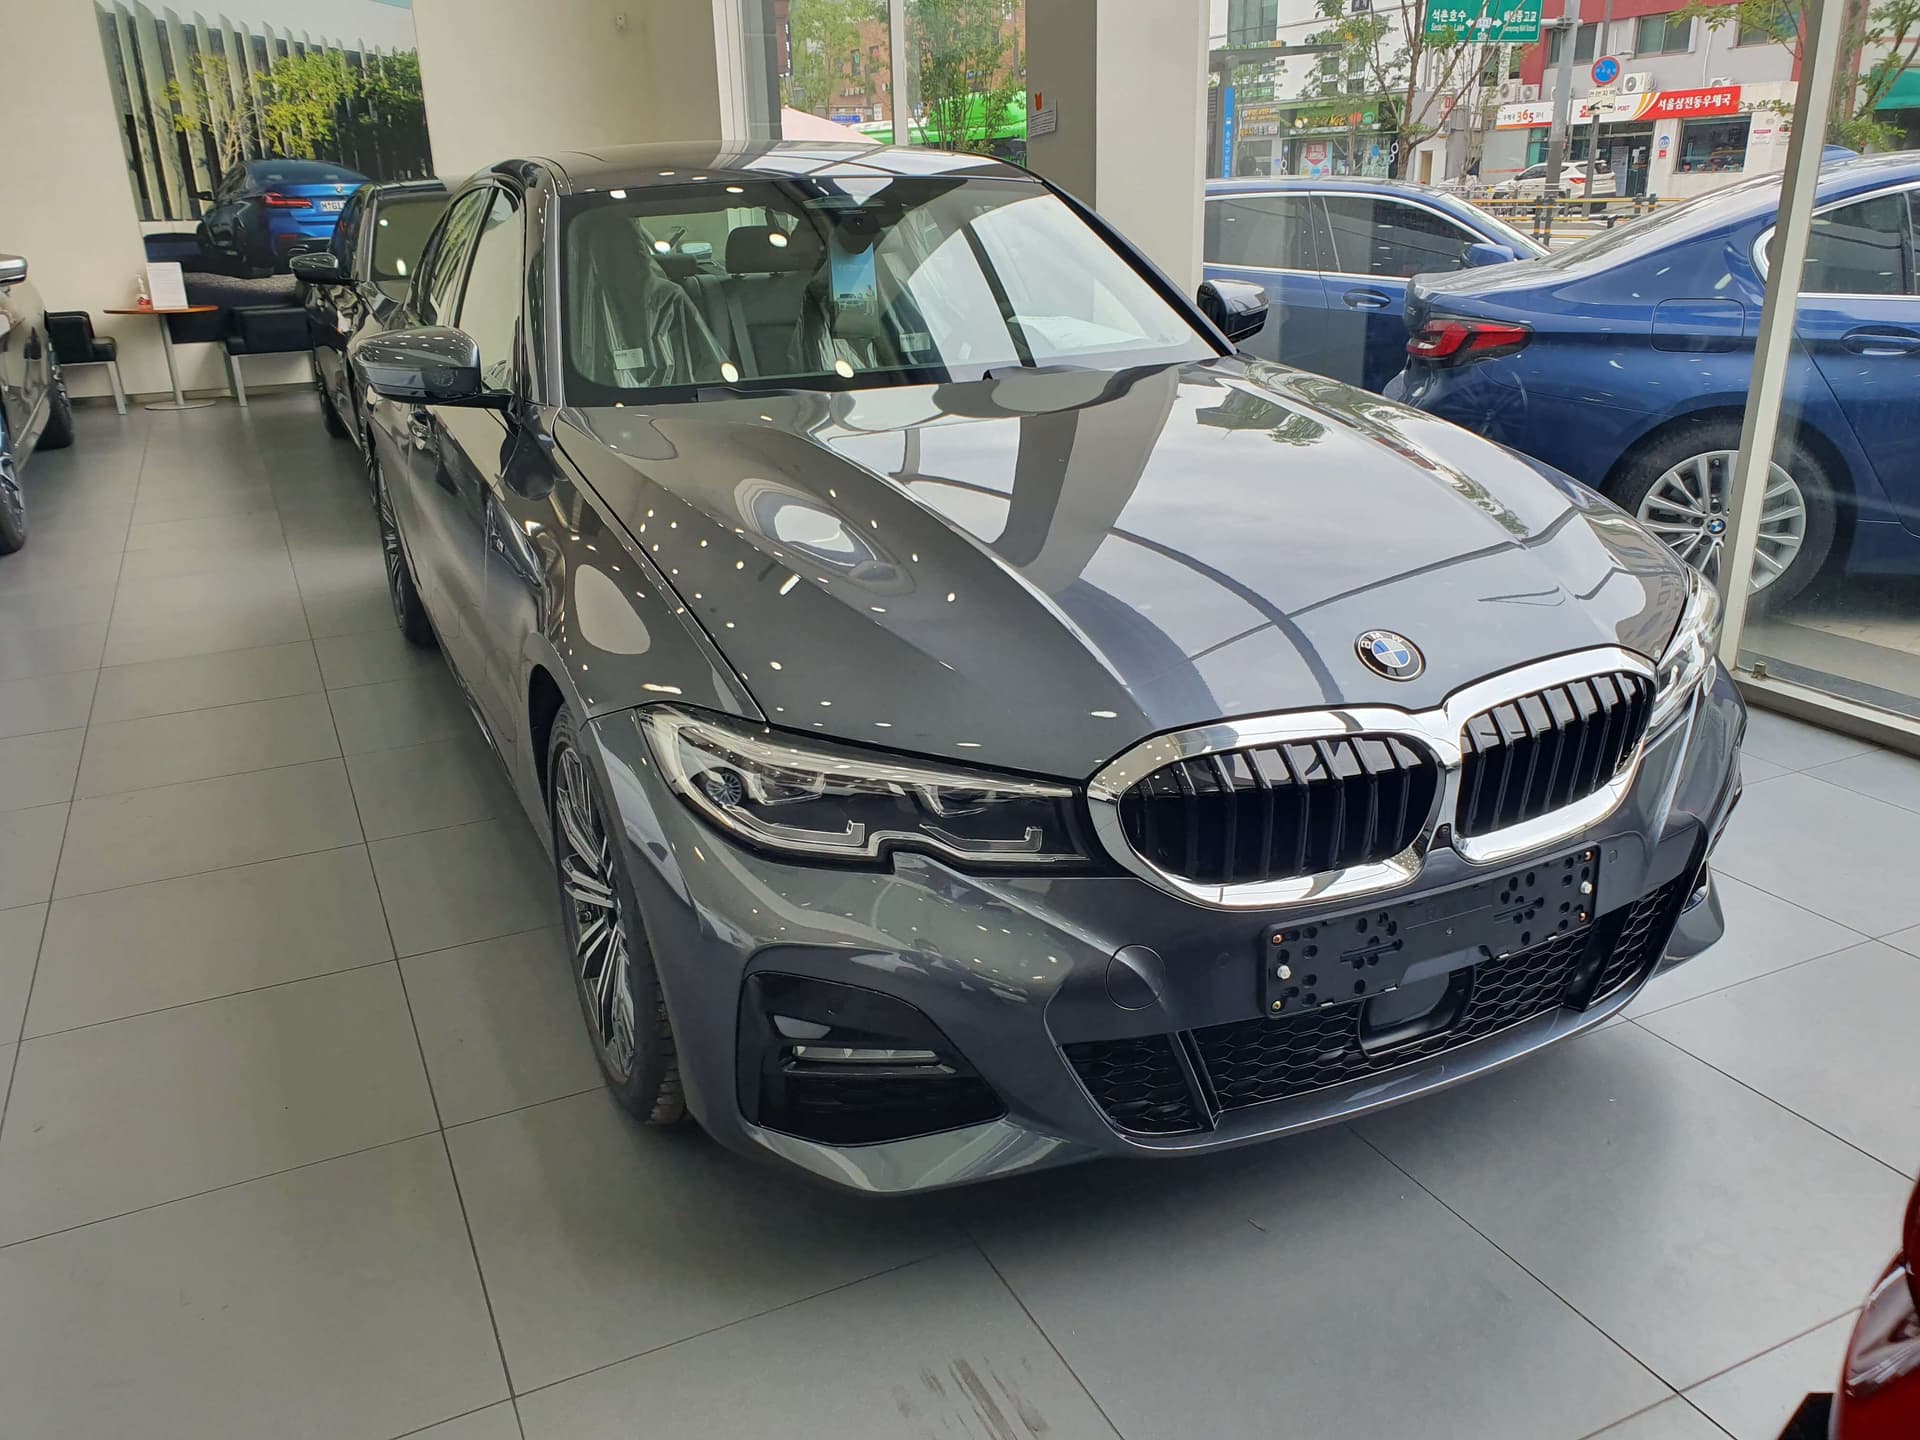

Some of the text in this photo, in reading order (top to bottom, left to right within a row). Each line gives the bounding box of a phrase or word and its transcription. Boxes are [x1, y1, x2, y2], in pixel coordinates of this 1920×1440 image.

[1658, 93, 1731, 111] 서울삼전동우체국
[1516, 109, 1534, 123] 365
[1360, 632, 1403, 649] BMW
